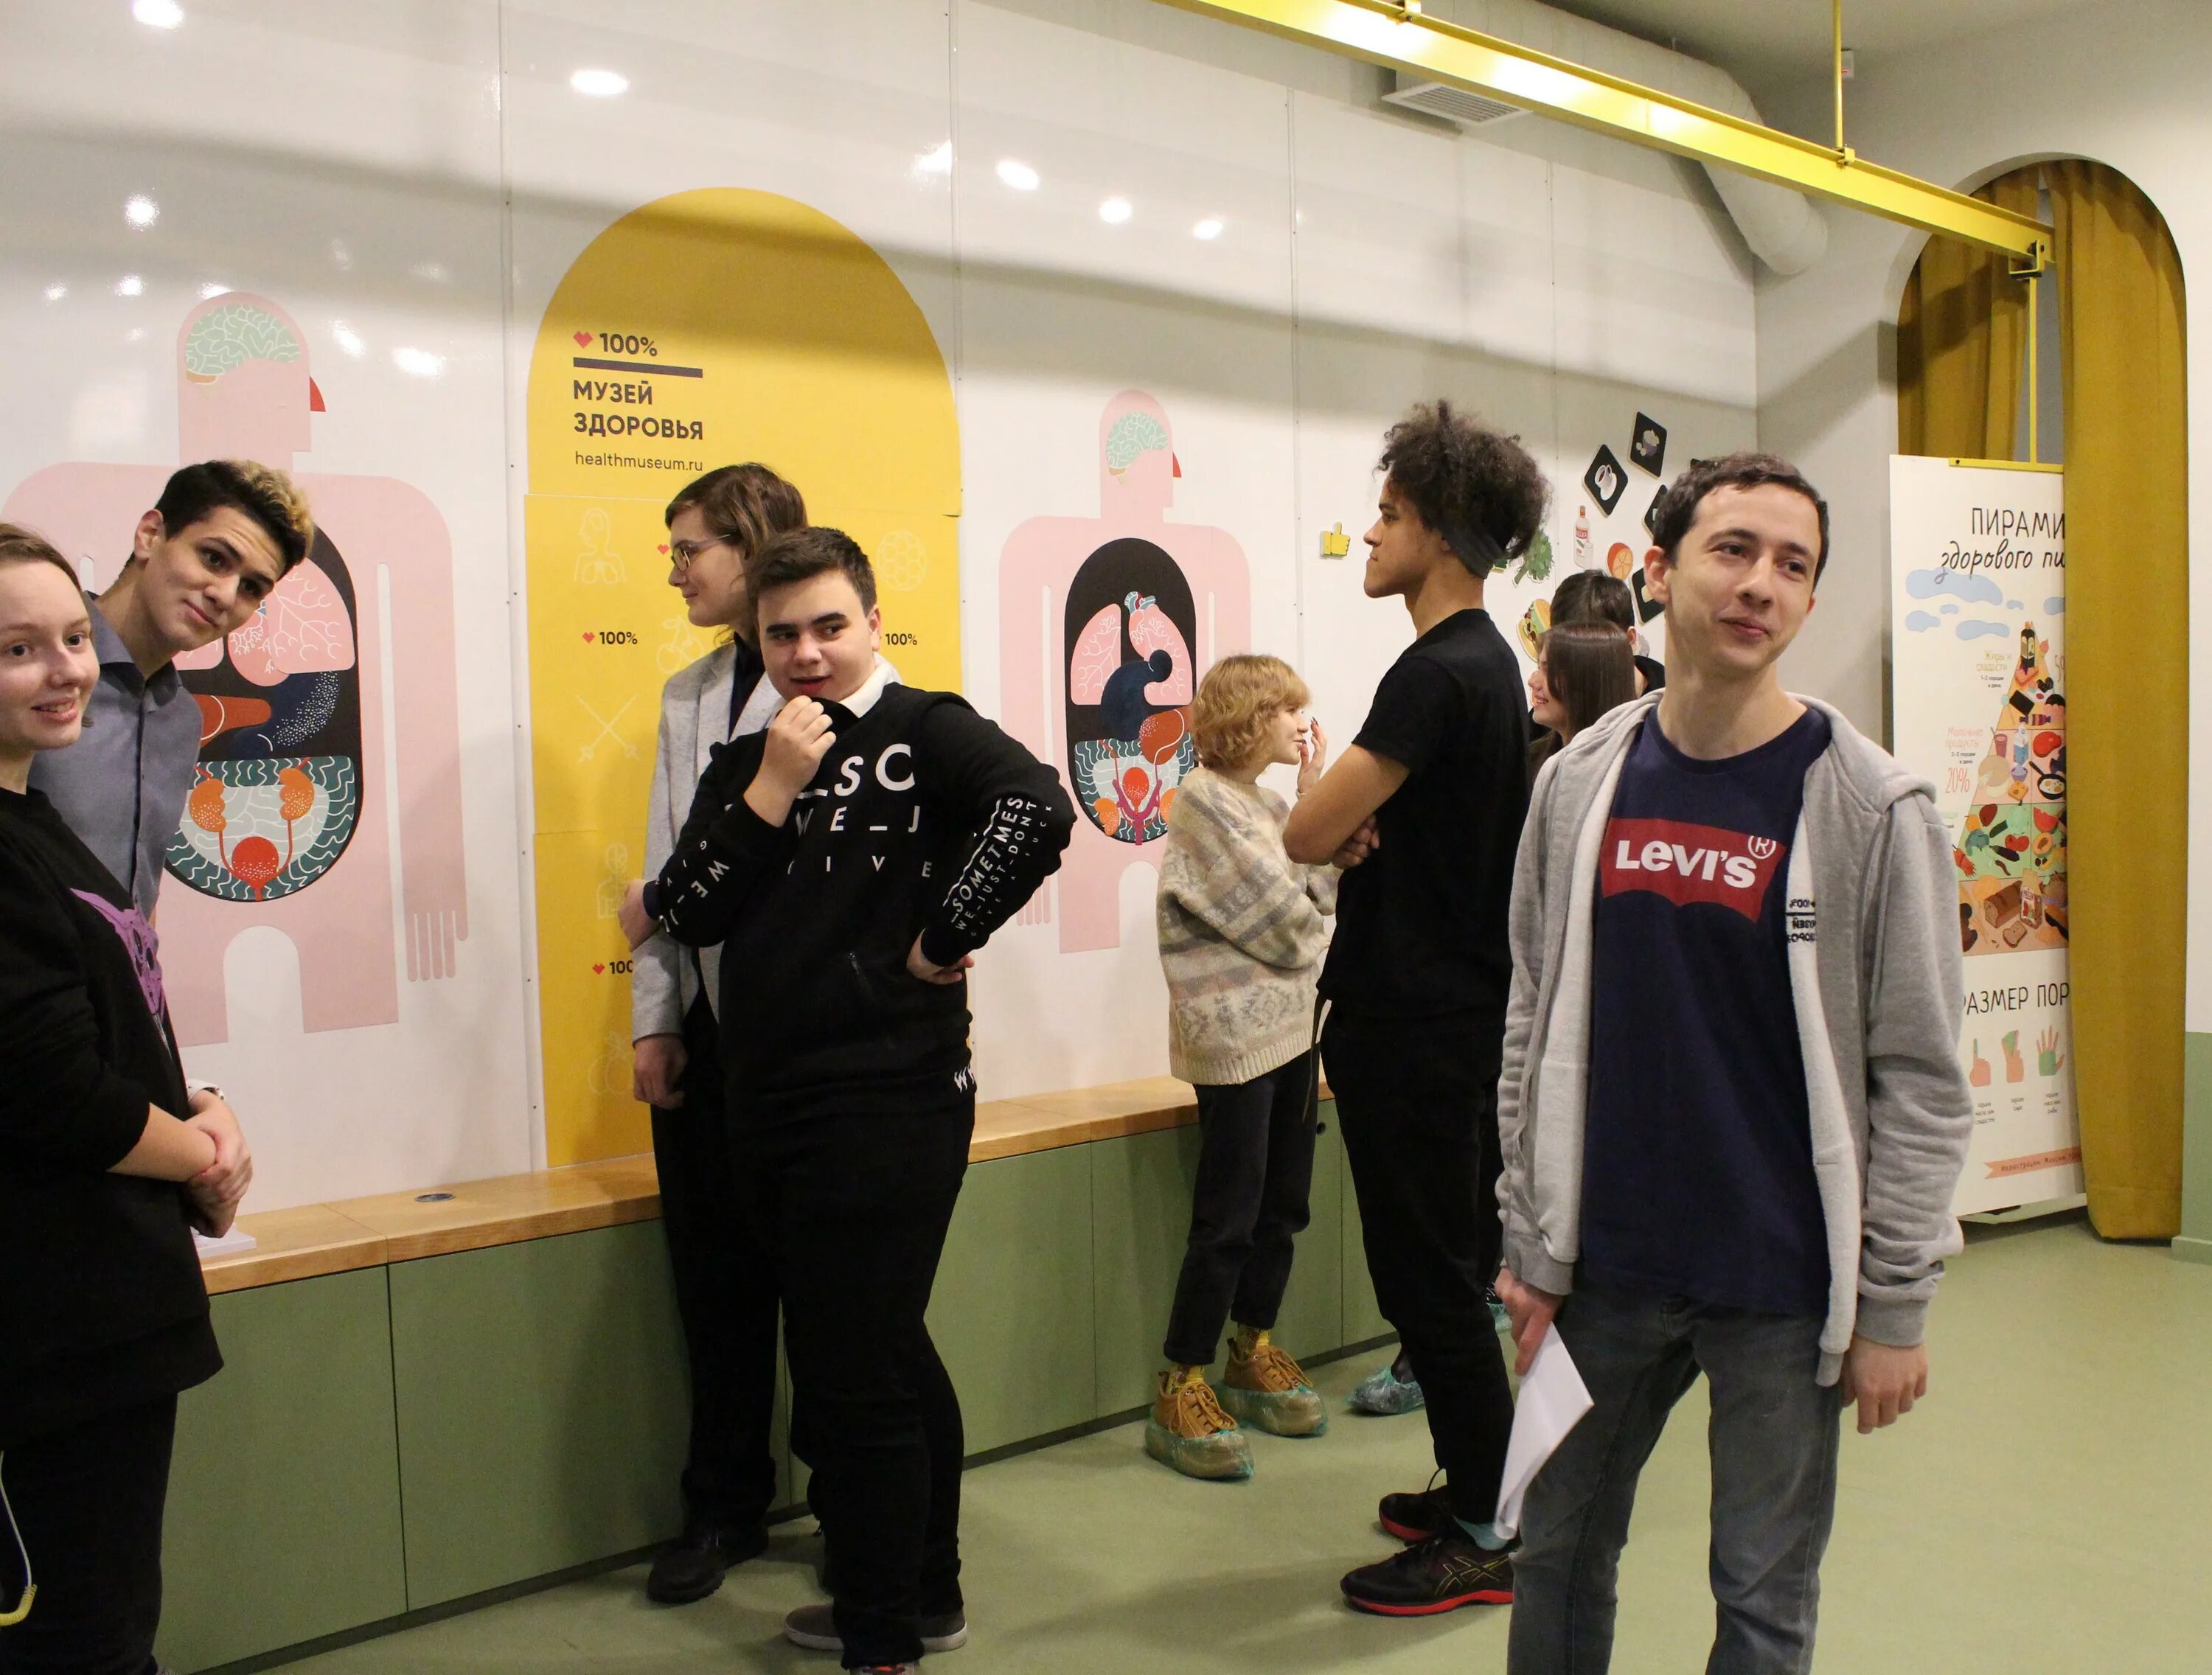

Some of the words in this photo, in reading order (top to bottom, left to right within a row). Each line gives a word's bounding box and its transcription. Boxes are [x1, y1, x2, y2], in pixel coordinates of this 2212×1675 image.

[599, 332, 658, 357] 100%
[573, 380, 653, 405] МУЗЕЙ
[574, 412, 703, 440] ЗДОРОВЬЯ
[575, 450, 703, 472] healthmuseum.ru
[1934, 538, 2033, 585] здорового
[599, 632, 638, 644] 100%
[885, 633, 917, 645] 100%
[1945, 767, 1970, 794] 20%
[2037, 982, 2070, 1008] ПОР
